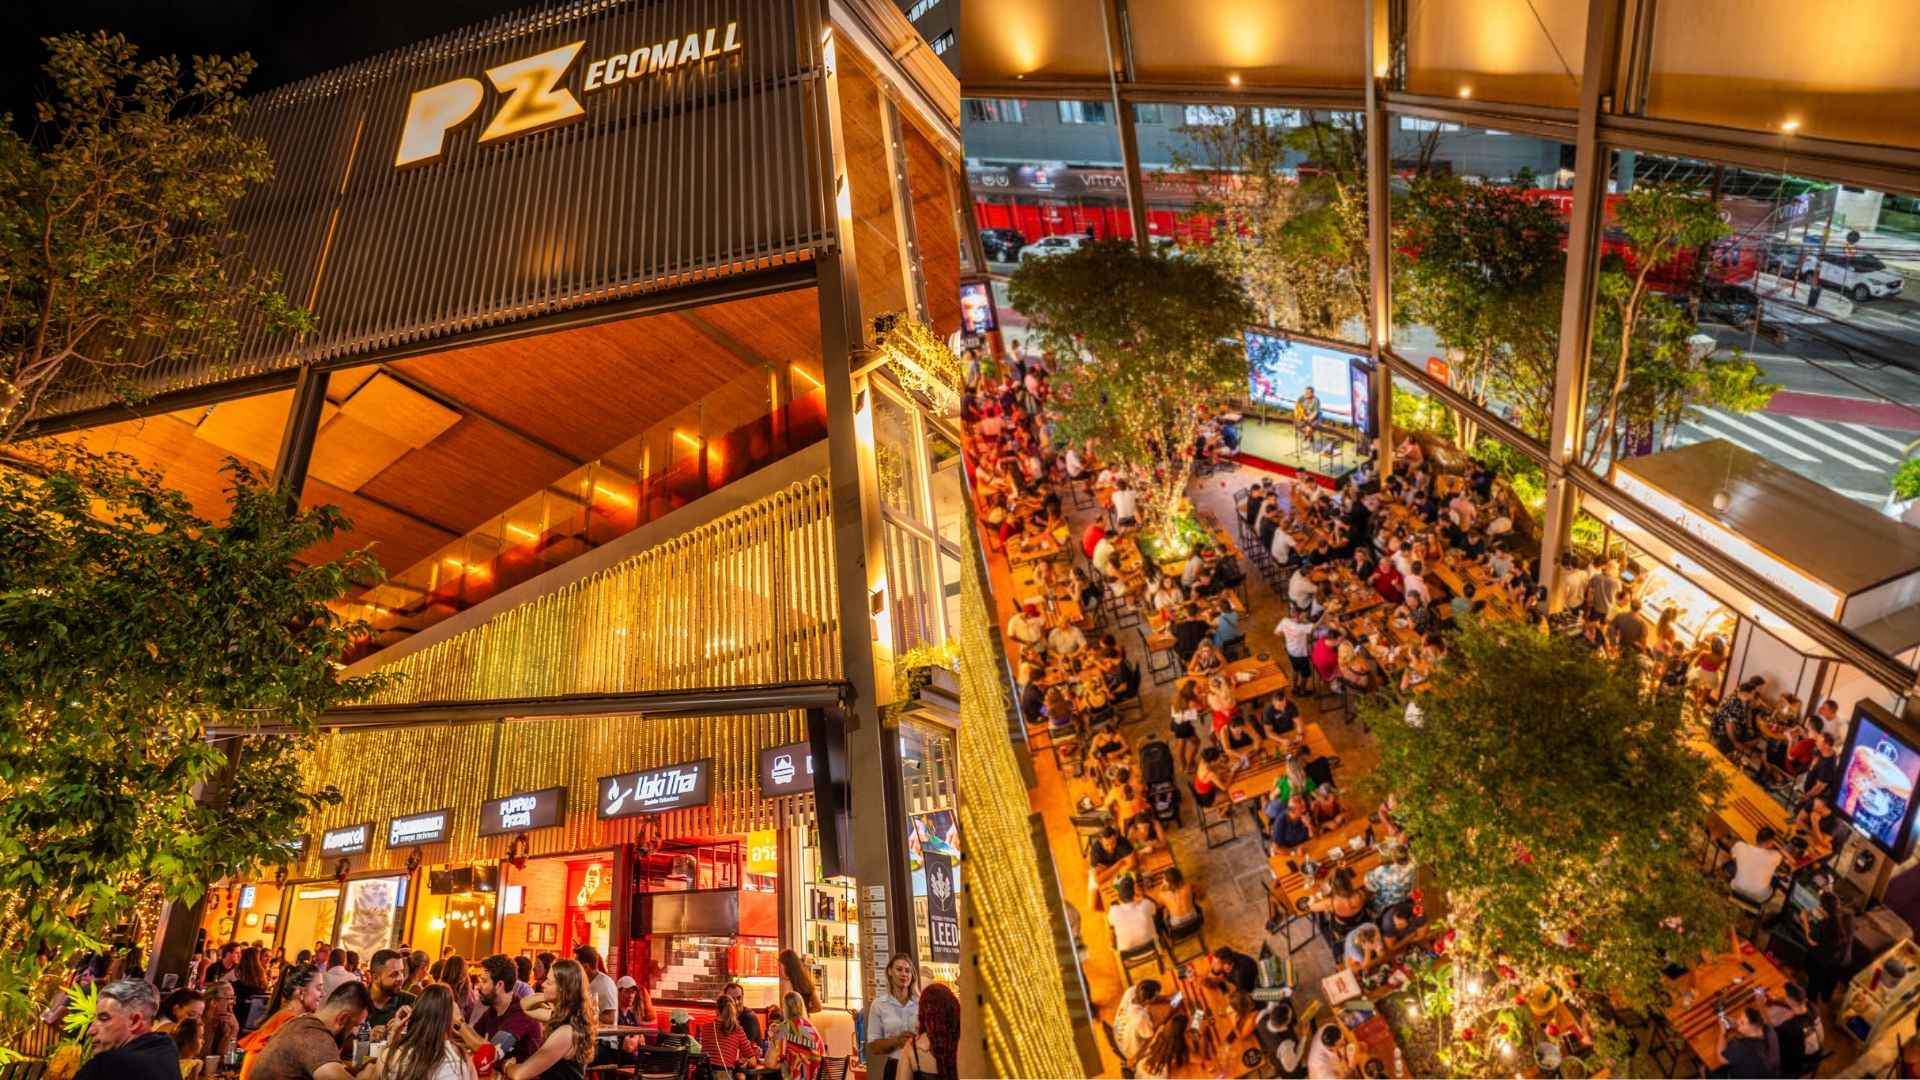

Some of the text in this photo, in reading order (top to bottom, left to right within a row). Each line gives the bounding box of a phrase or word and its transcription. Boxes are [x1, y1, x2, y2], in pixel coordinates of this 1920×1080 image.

[395, 22, 742, 167] PZ ECOMALL
[666, 766, 698, 795] Thai
[932, 921, 959, 946] LEED
